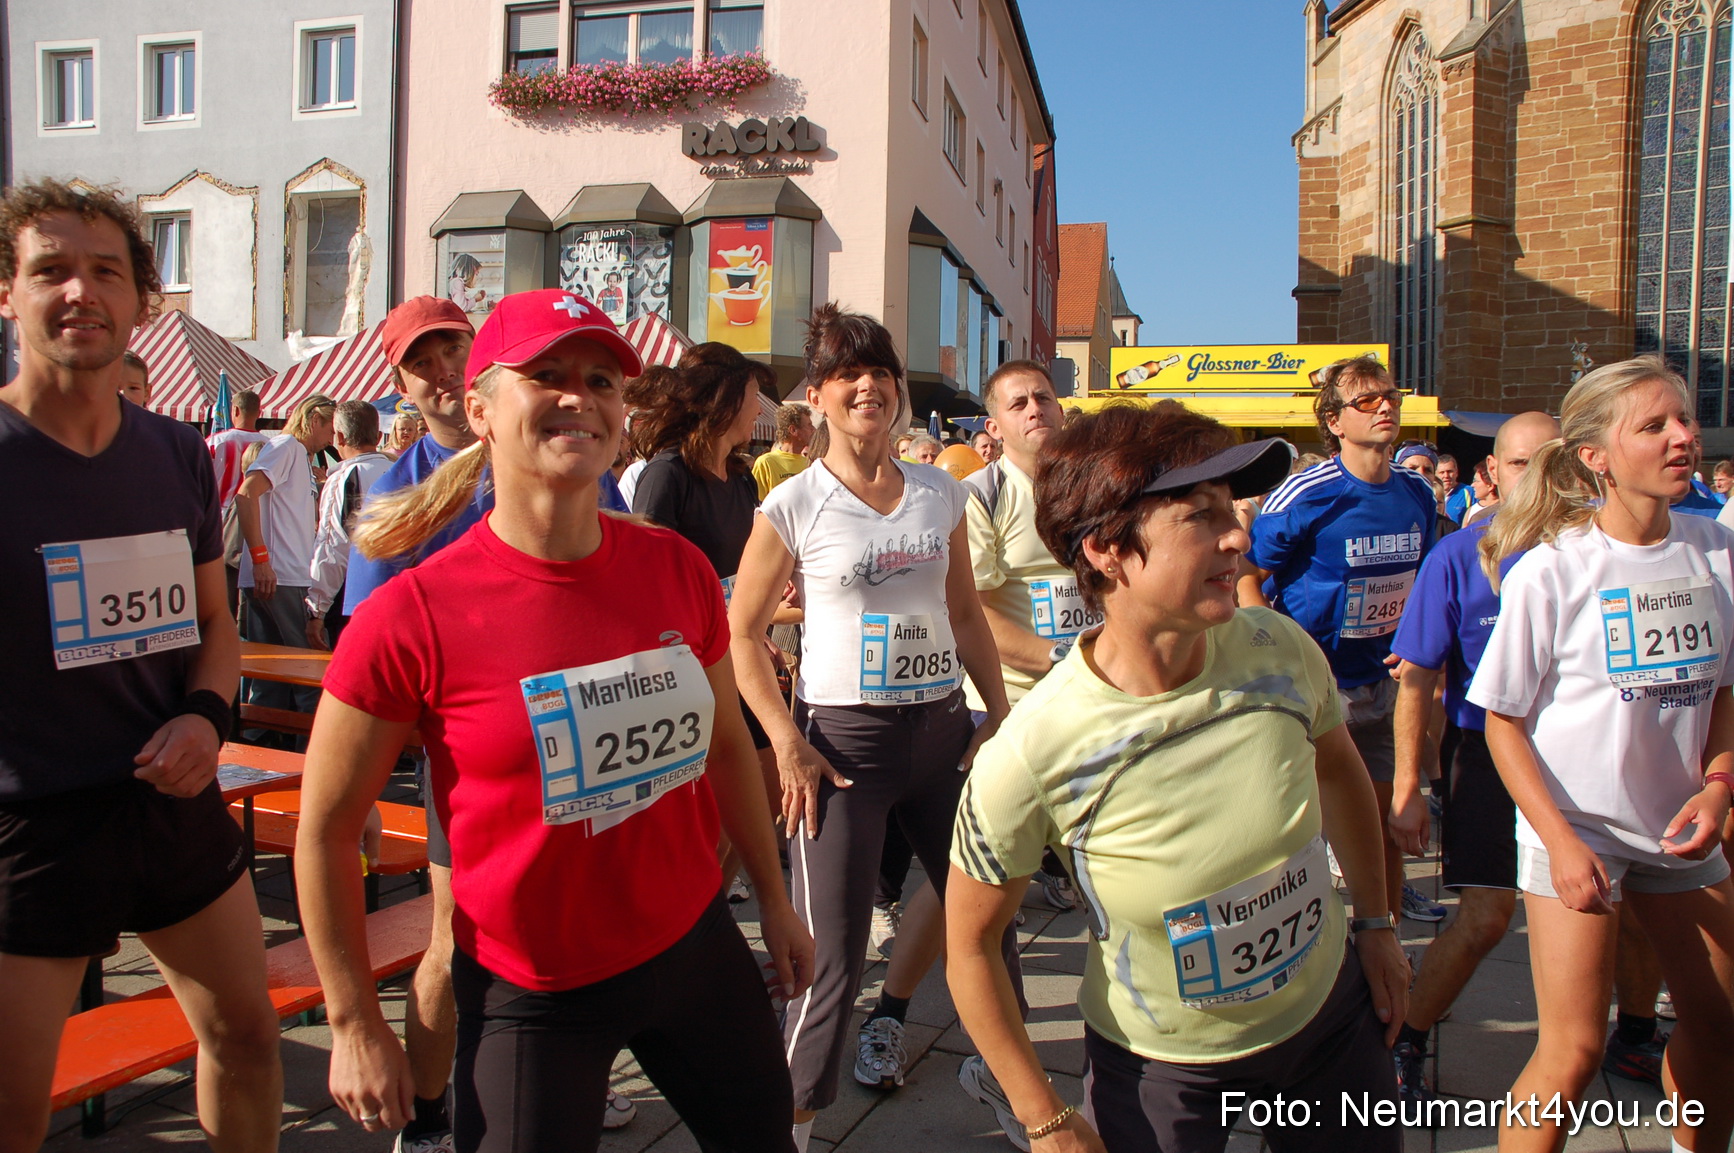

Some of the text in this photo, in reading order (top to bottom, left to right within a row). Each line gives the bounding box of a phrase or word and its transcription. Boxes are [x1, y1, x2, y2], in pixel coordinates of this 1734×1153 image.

[682, 116, 821, 156] RACKL
[583, 228, 625, 241] 100 Jahre
[1186, 352, 1305, 382] Glossner-Bier
[1345, 532, 1421, 557] HUBER
[1364, 553, 1418, 564] TECHNOLOGY
[1367, 581, 1405, 595] Matthias
[1637, 591, 1693, 613] Martina
[100, 584, 186, 627] 3510
[1366, 598, 1405, 621] 2481
[58, 628, 197, 663] BOCK PFLEIDERER
[893, 623, 928, 640] Anita
[1610, 620, 1713, 657] C 2191
[866, 649, 952, 680] D 2085
[578, 671, 678, 709] Marliese
[545, 711, 701, 775] D 2523
[1217, 868, 1308, 926] Veronika
[1183, 954, 1195, 971] D
[1232, 897, 1322, 975] 3273
